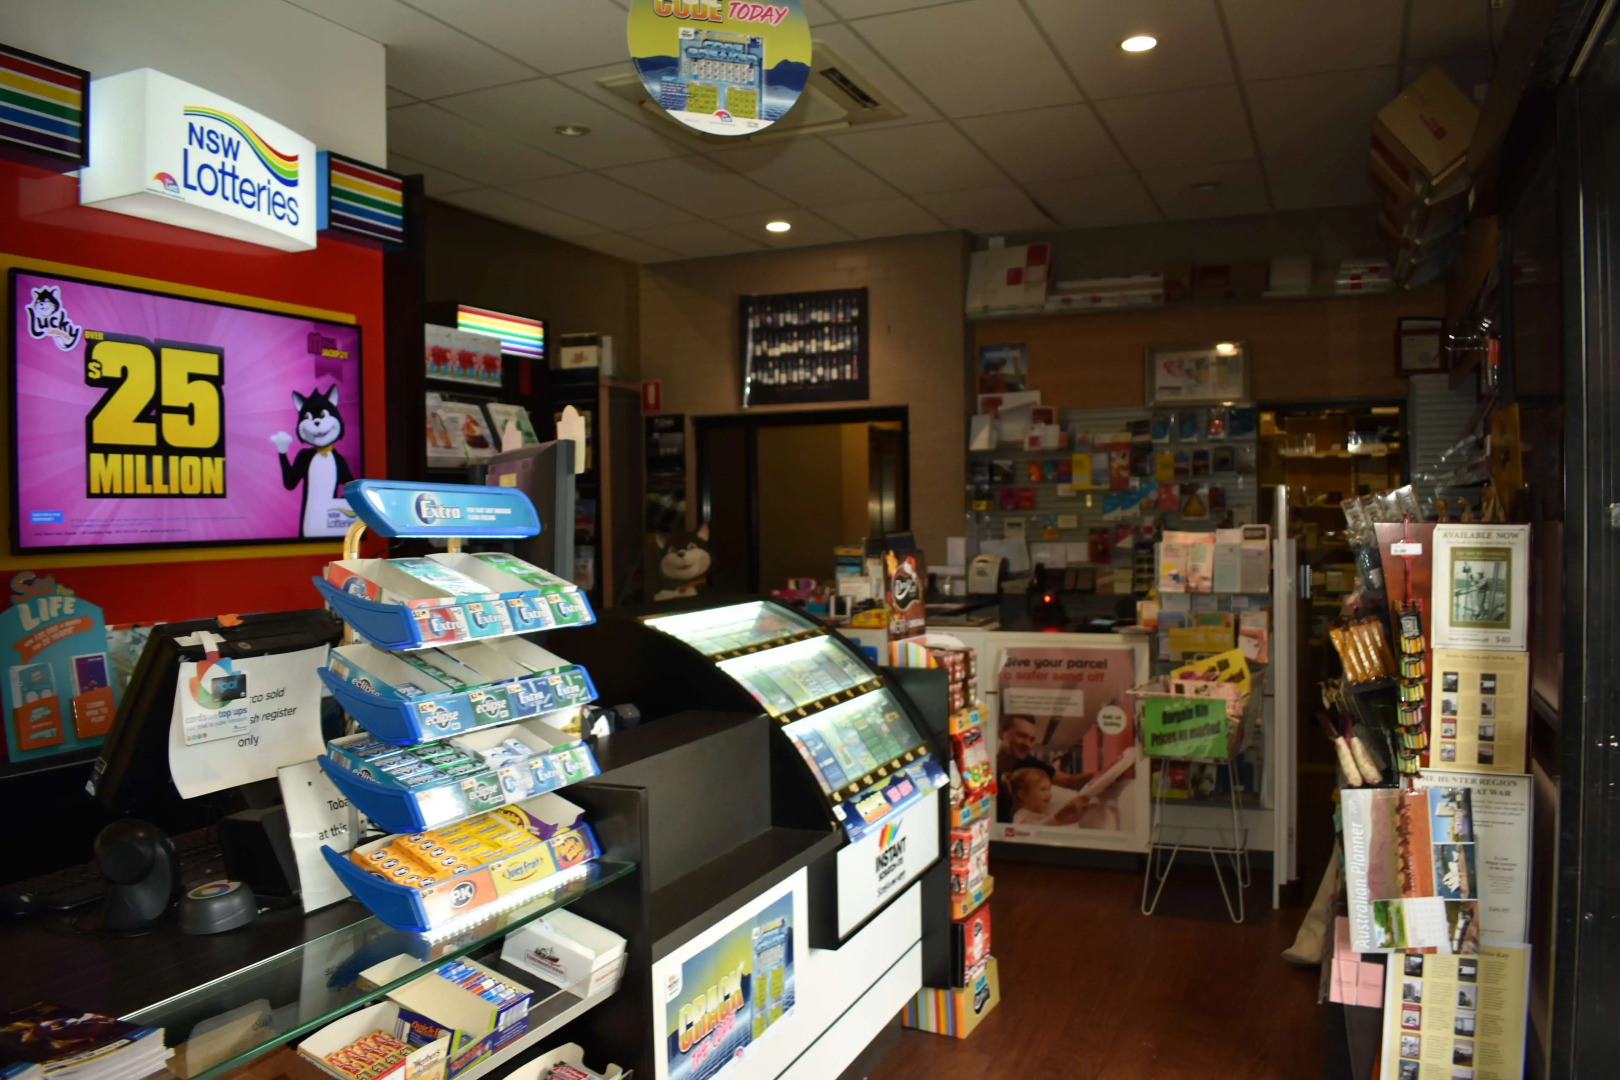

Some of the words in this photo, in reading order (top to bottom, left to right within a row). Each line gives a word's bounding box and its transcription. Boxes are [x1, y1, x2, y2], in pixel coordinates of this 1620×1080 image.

[729, 1, 788, 25] TODAY
[188, 122, 241, 161] NSW
[183, 148, 299, 226] Lotteries
[28, 306, 80, 349] Lucky
[89, 452, 224, 495] MILLION
[420, 498, 461, 520] Extra
[1442, 531, 1493, 540] AVAILABLE
[1496, 532, 1520, 540] NOW
[18, 595, 76, 631] LIFE
[475, 611, 504, 625] Extra
[431, 618, 464, 632] Extra
[1034, 659, 1063, 670] your
[1066, 659, 1107, 669] parcel
[1003, 672, 1012, 680] a
[1016, 671, 1048, 681] safer
[1052, 672, 1084, 682] send
[1087, 672, 1105, 682] off
[250, 694, 264, 704] co
[265, 687, 286, 701] sold
[518, 692, 544, 705] Extra
[556, 684, 580, 697] Extra
[218, 709, 232, 719] top
[233, 707, 248, 717] ups
[262, 707, 297, 722] register
[475, 699, 507, 716] eclipse
[426, 711, 459, 727] eclipse
[237, 735, 260, 748] only
[1438, 775, 1478, 786] HUNTER
[1479, 778, 1518, 787] REGION
[469, 785, 499, 800] eclipse
[318, 829, 329, 841] at
[330, 823, 348, 837] this
[875, 836, 906, 874] INSTANT
[1349, 822, 1368, 875] Planner
[450, 886, 472, 904] PK
[1350, 876, 1371, 949] Australian
[678, 965, 744, 1053] CRACK
